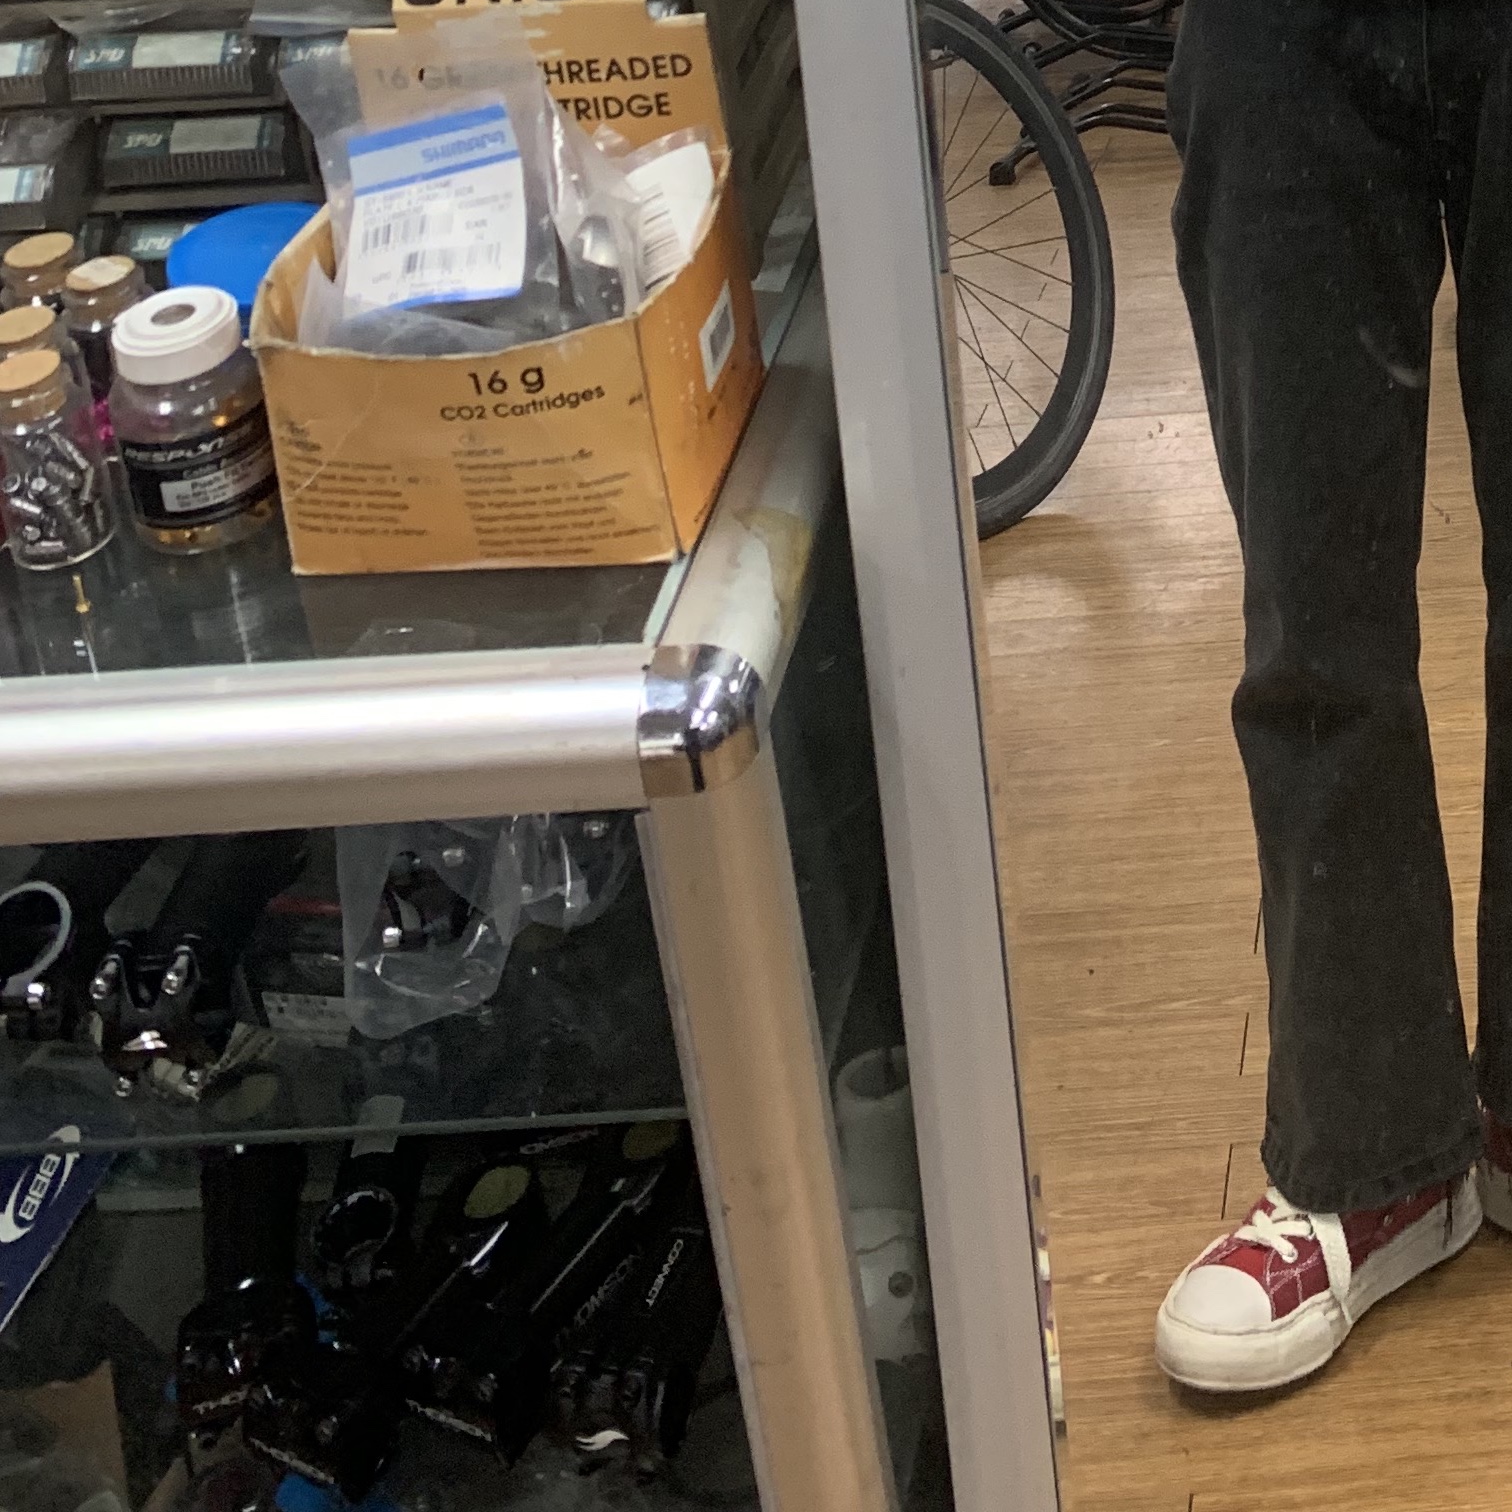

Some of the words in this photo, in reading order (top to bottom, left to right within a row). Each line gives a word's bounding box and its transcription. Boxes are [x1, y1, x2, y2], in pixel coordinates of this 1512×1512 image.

[536, 53, 693, 85] HREADED
[556, 91, 672, 121] TRIDGE
[468, 369, 508, 395] 16
[520, 366, 546, 394] g
[439, 405, 487, 422] CO2
[492, 385, 606, 419] Cartridges
